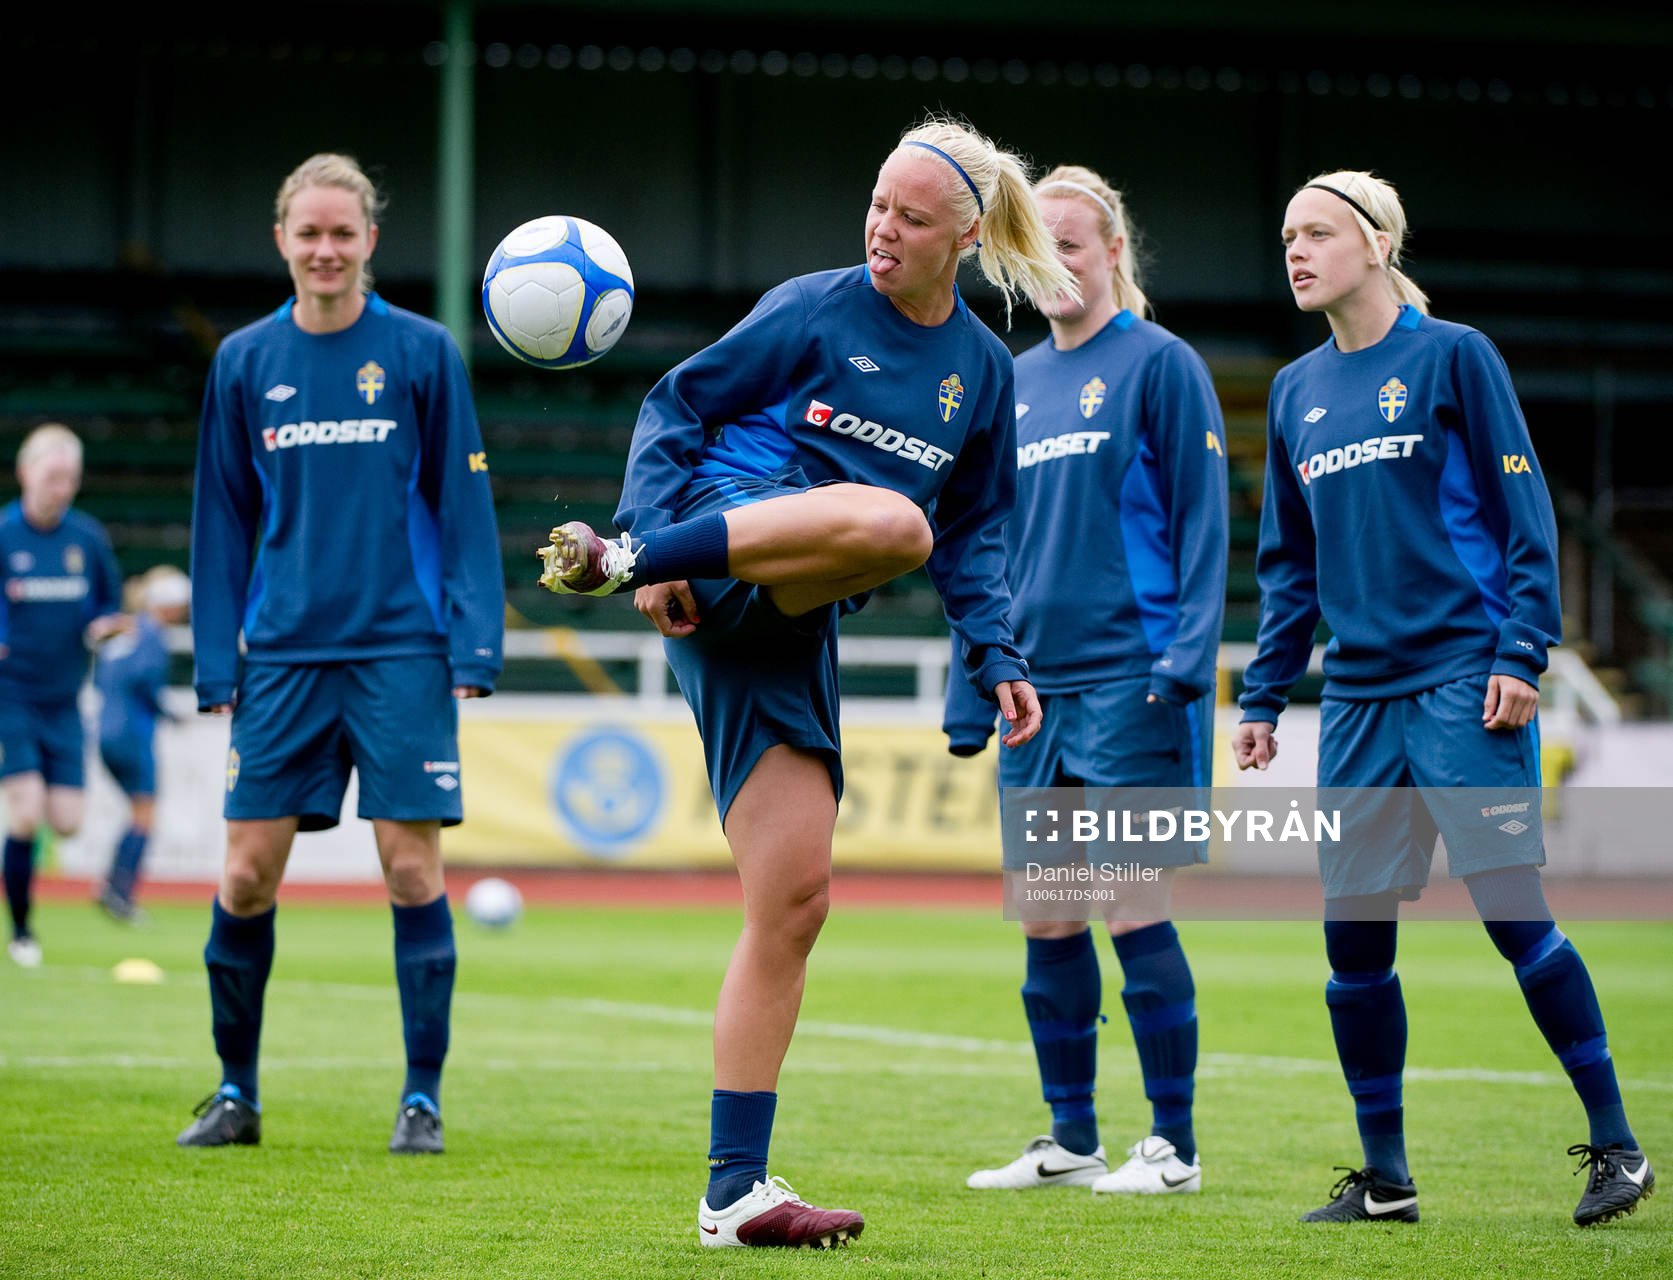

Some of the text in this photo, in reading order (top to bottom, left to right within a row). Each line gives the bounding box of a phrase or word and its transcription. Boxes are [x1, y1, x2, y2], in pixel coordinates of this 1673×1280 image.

[275, 419, 397, 449] ODDSET
[830, 413, 954, 471] ODDSET
[1017, 431, 1111, 470] DDSET
[1308, 434, 1424, 480] ODDSET
[1502, 454, 1532, 474] ICA
